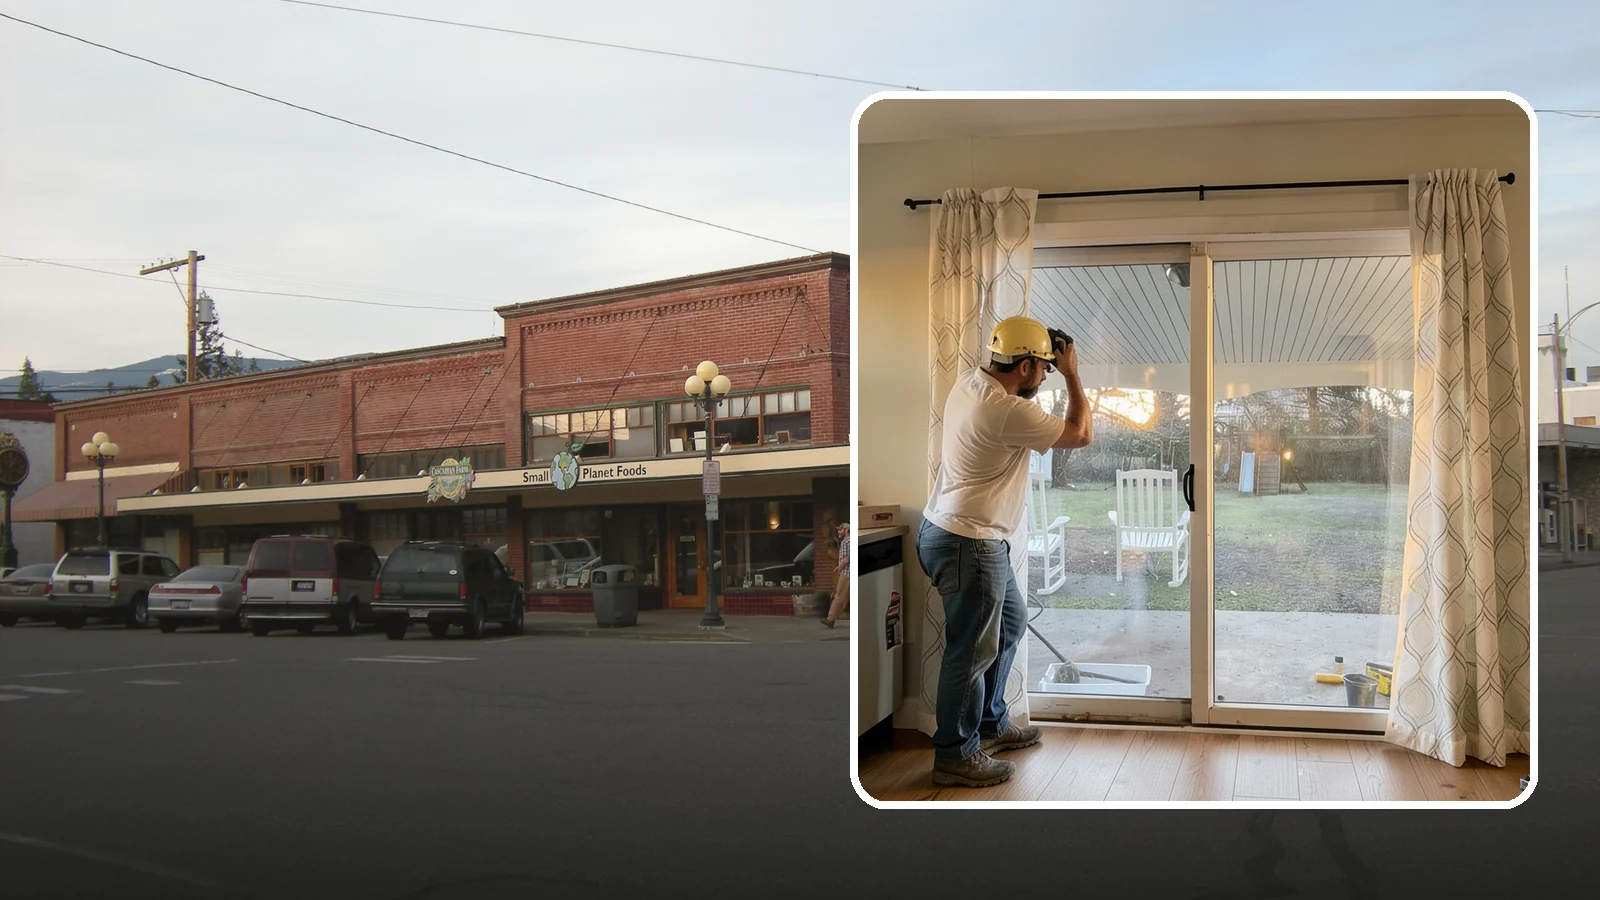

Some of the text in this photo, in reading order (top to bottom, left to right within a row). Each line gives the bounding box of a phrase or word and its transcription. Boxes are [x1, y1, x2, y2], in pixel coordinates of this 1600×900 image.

[523, 464, 647, 483] Small Planet Foods
